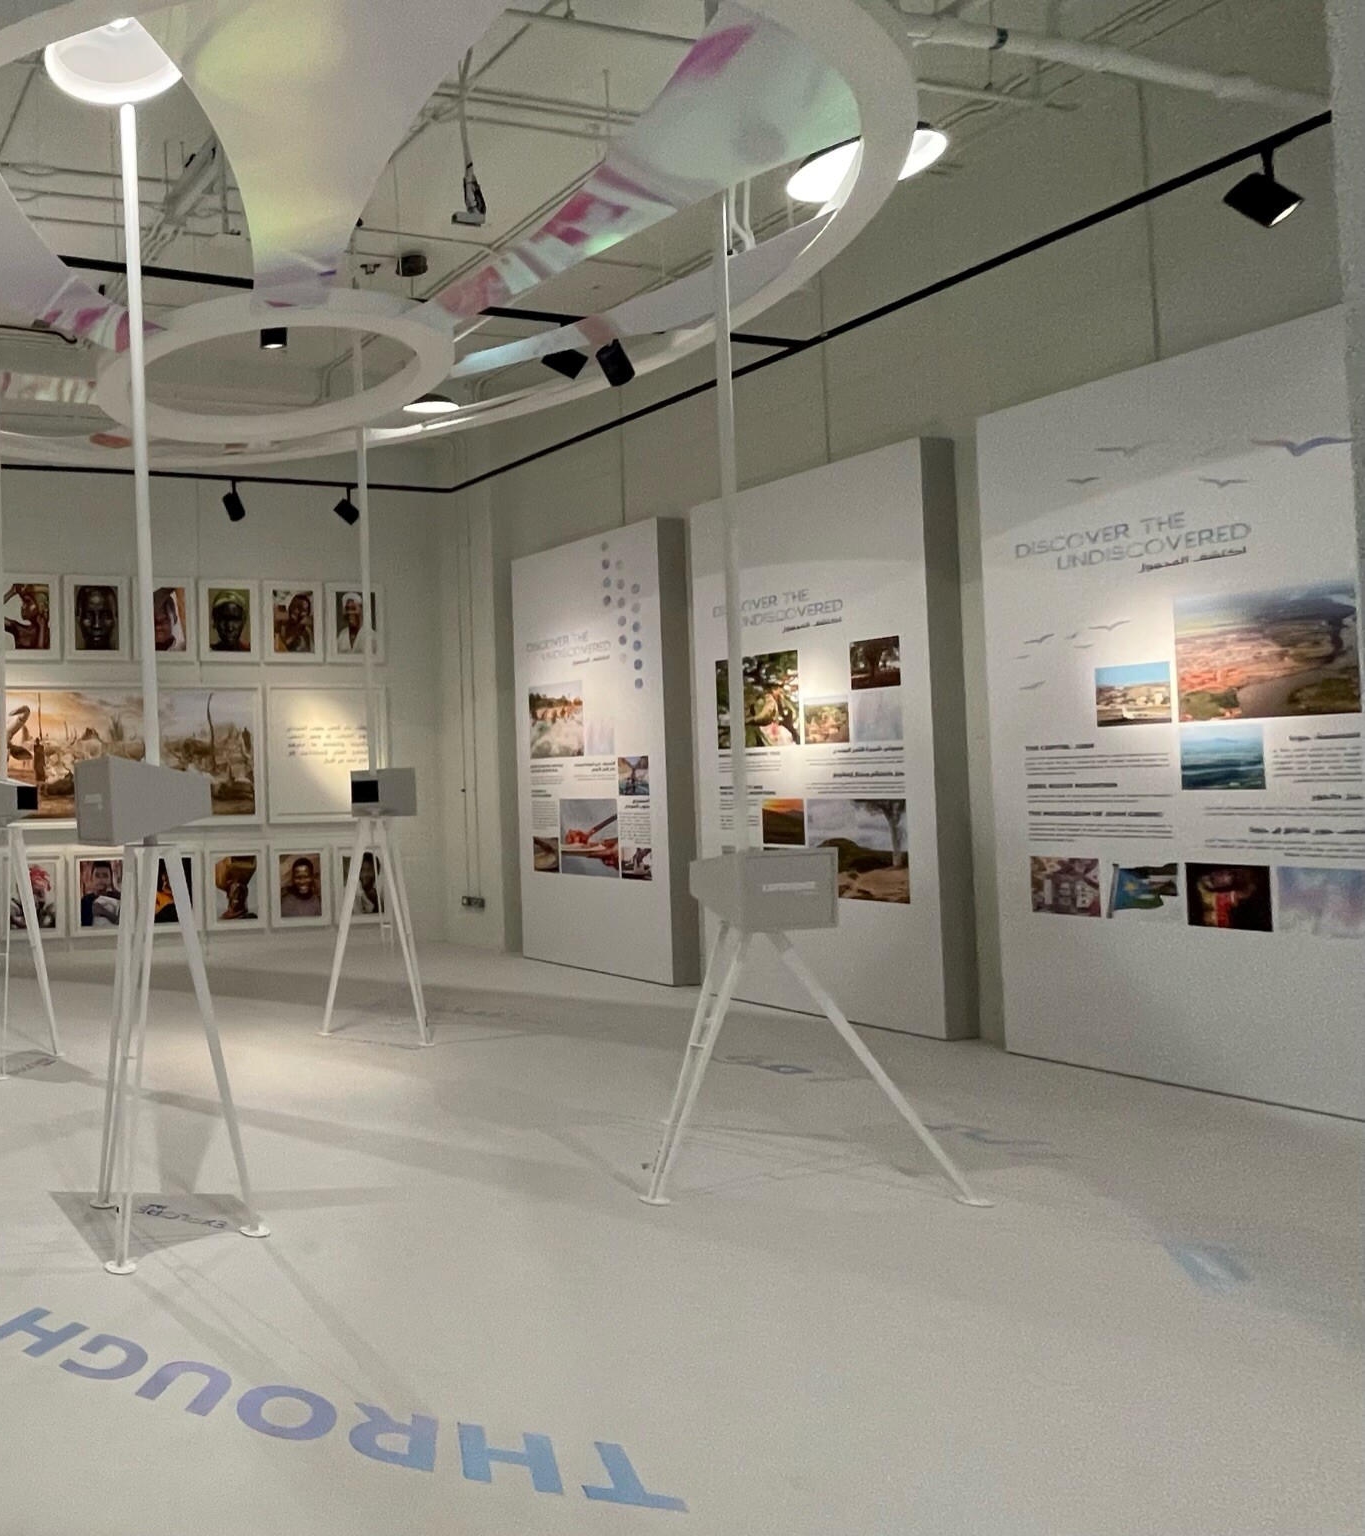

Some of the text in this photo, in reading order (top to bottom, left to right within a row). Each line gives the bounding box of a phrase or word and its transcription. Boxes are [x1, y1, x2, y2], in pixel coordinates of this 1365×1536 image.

[1014, 511, 1187, 559] DISCOVER THE
[1056, 521, 1252, 571] UNDISCOVERED
[781, 588, 811, 606] THE
[741, 598, 844, 628] NDISCOVERED
[526, 634, 569, 653] DISCOVER
